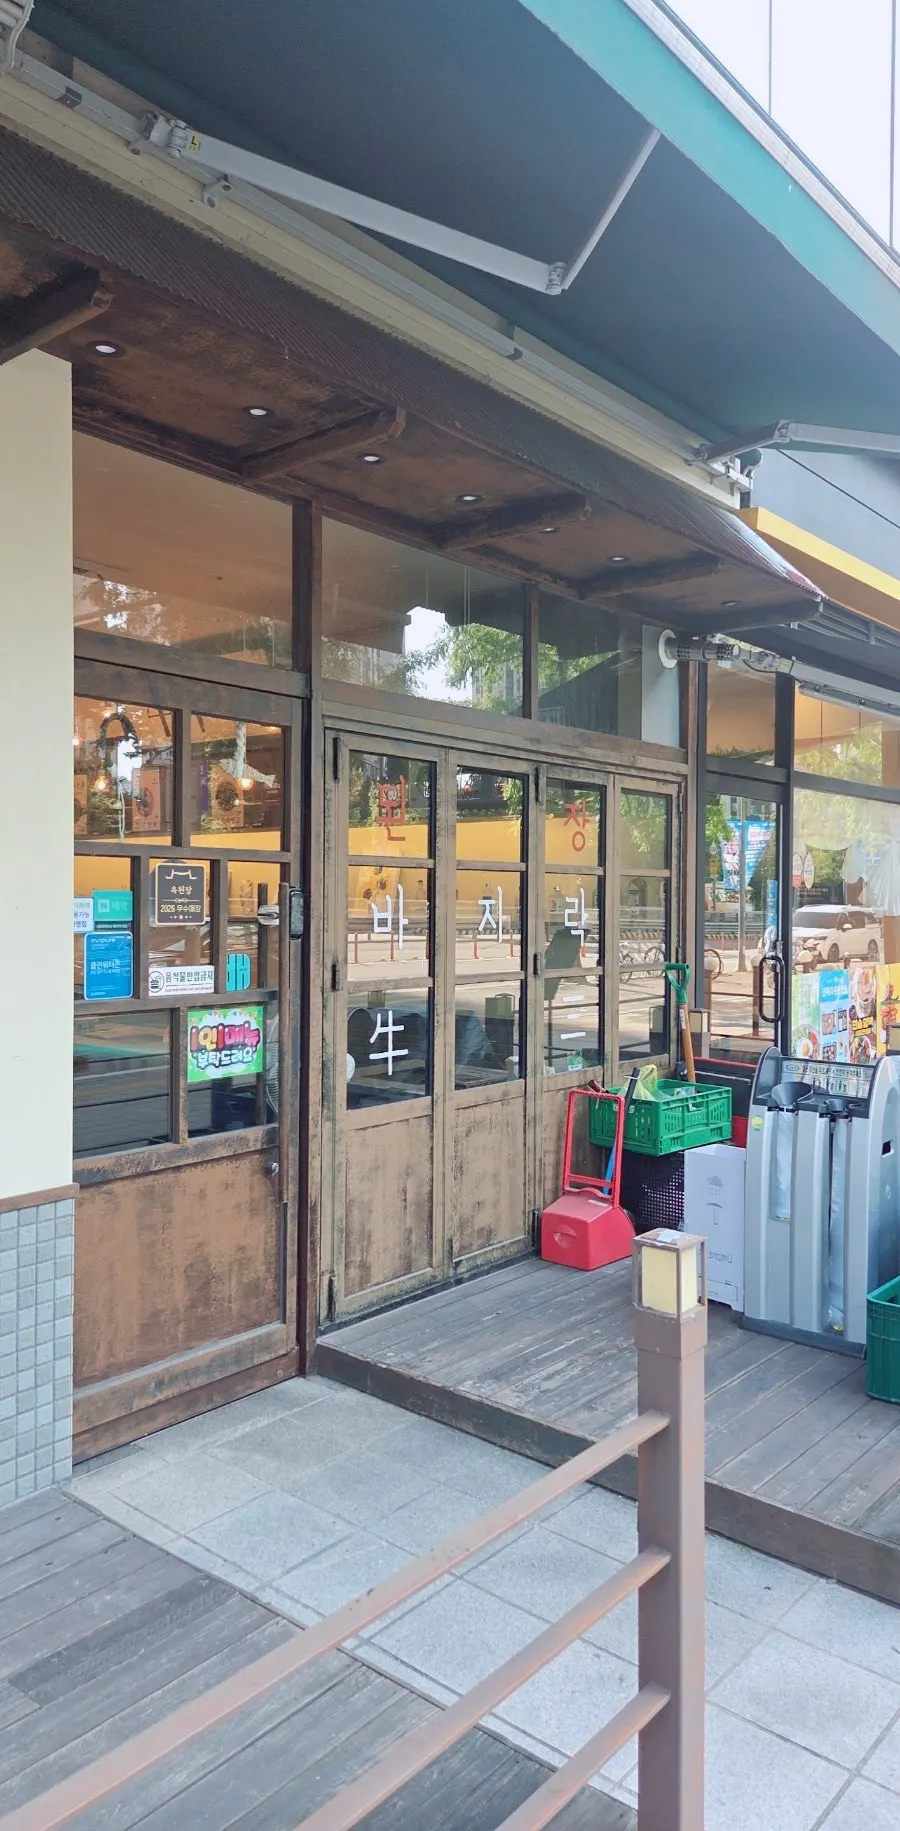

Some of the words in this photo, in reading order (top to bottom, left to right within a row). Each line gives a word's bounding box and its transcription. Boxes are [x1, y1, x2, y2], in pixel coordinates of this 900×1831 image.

[563, 799, 590, 852] 장
[371, 883, 408, 950] 바
[477, 885, 504, 943] 지
[563, 887, 589, 948] 락
[197, 1047, 253, 1070] 부탁드려요
[369, 1009, 409, 1076] 牛
